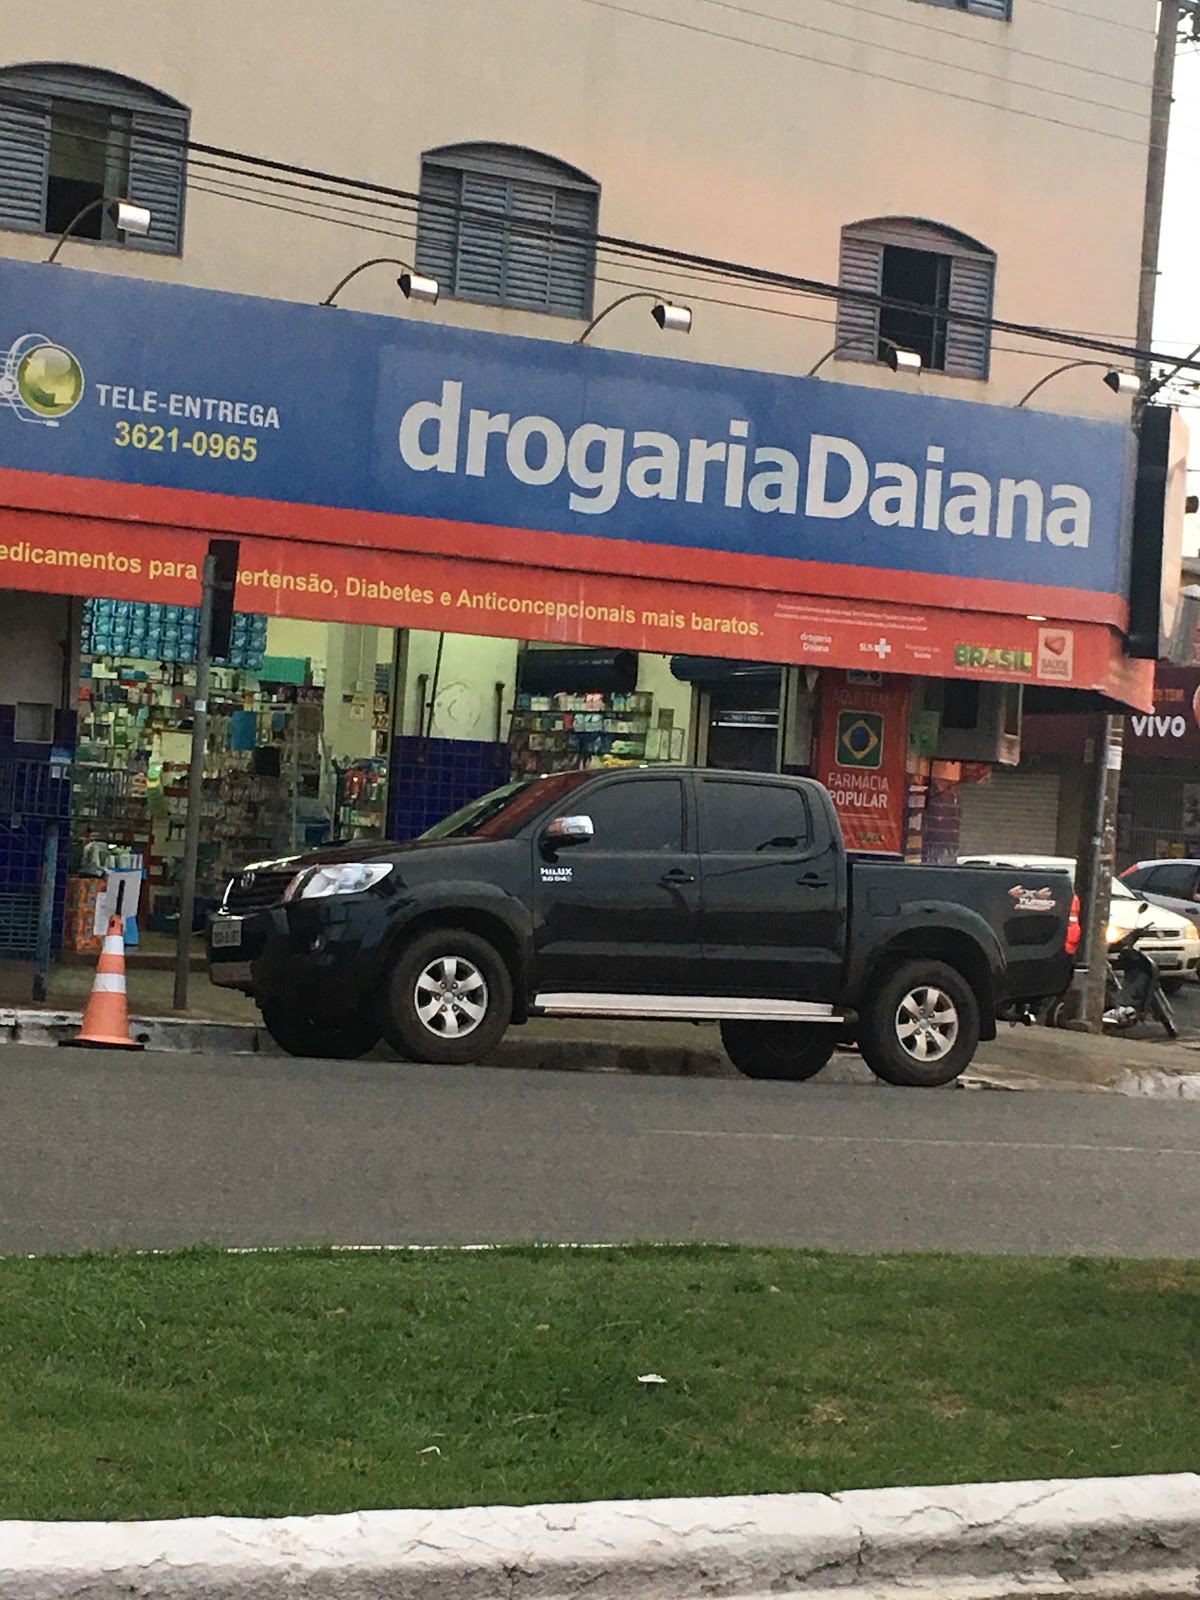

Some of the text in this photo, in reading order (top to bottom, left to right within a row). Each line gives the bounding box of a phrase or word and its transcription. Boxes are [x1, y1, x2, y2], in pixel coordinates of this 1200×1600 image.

[96, 383, 281, 430] TELE-ENTREGA
[114, 420, 258, 462] 3621-0965
[149, 559, 198, 579] para
[346, 577, 434, 605] Diabetes
[440, 591, 452, 606] e
[457, 588, 636, 624] Anticoncepcionais
[642, 610, 686, 629] mais
[691, 612, 765, 637] baratos.
[955, 645, 1032, 672] BRASIL
[828, 772, 890, 792] FARMÁCIA
[540, 867, 573, 875] HILUX
